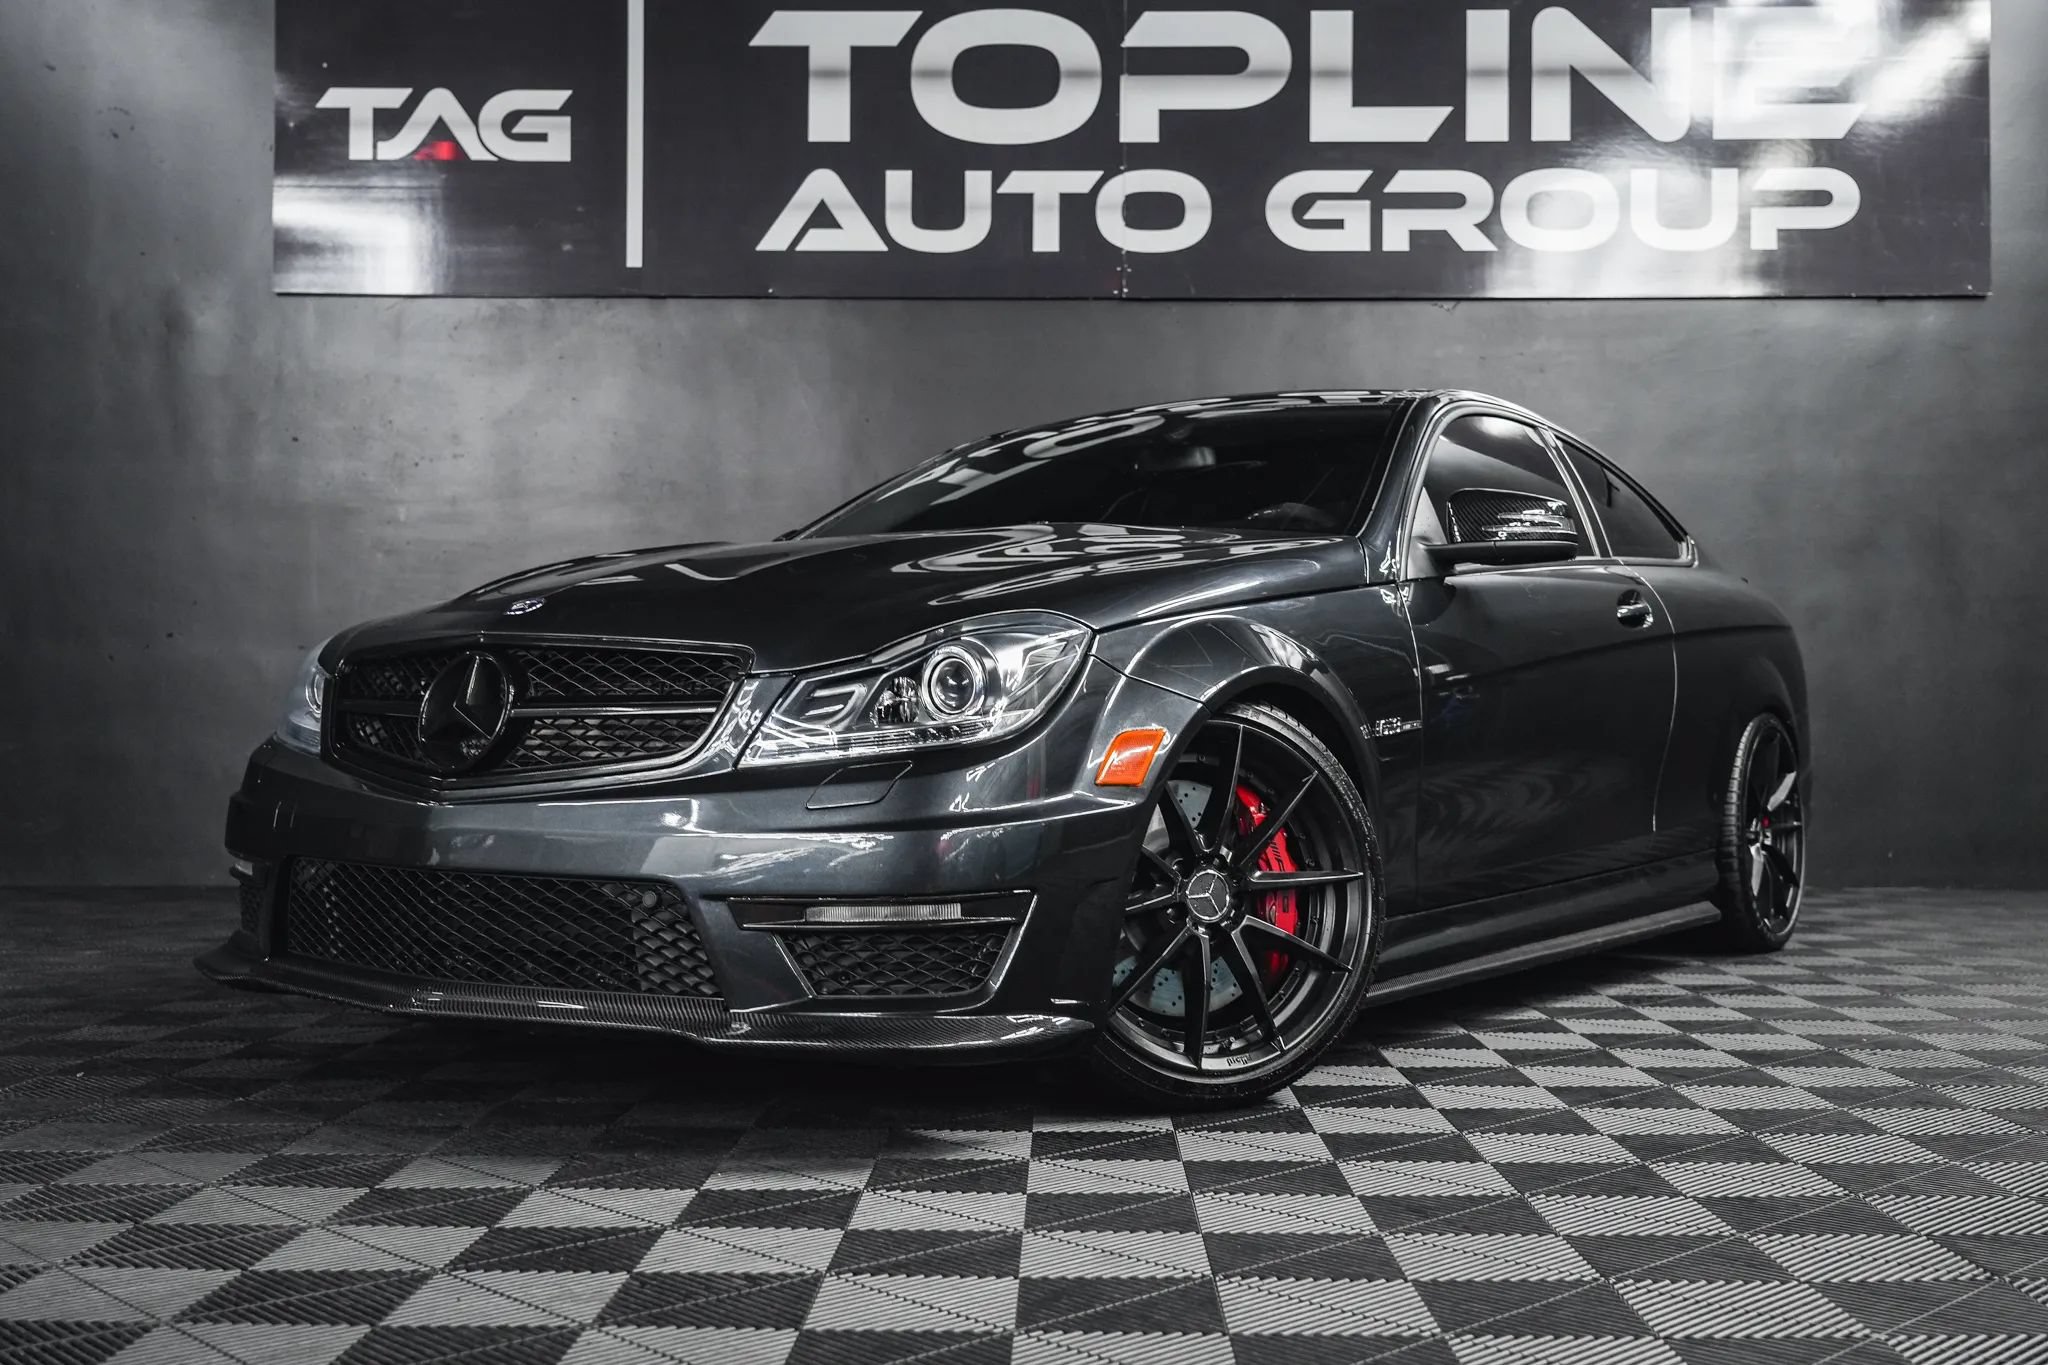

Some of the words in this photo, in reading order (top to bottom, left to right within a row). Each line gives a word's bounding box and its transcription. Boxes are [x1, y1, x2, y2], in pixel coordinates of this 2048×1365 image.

[748, 5, 1867, 145] TOPLINE
[315, 87, 573, 162] TAG
[755, 168, 1212, 253] AUTO
[1265, 167, 1861, 252] GROUP
